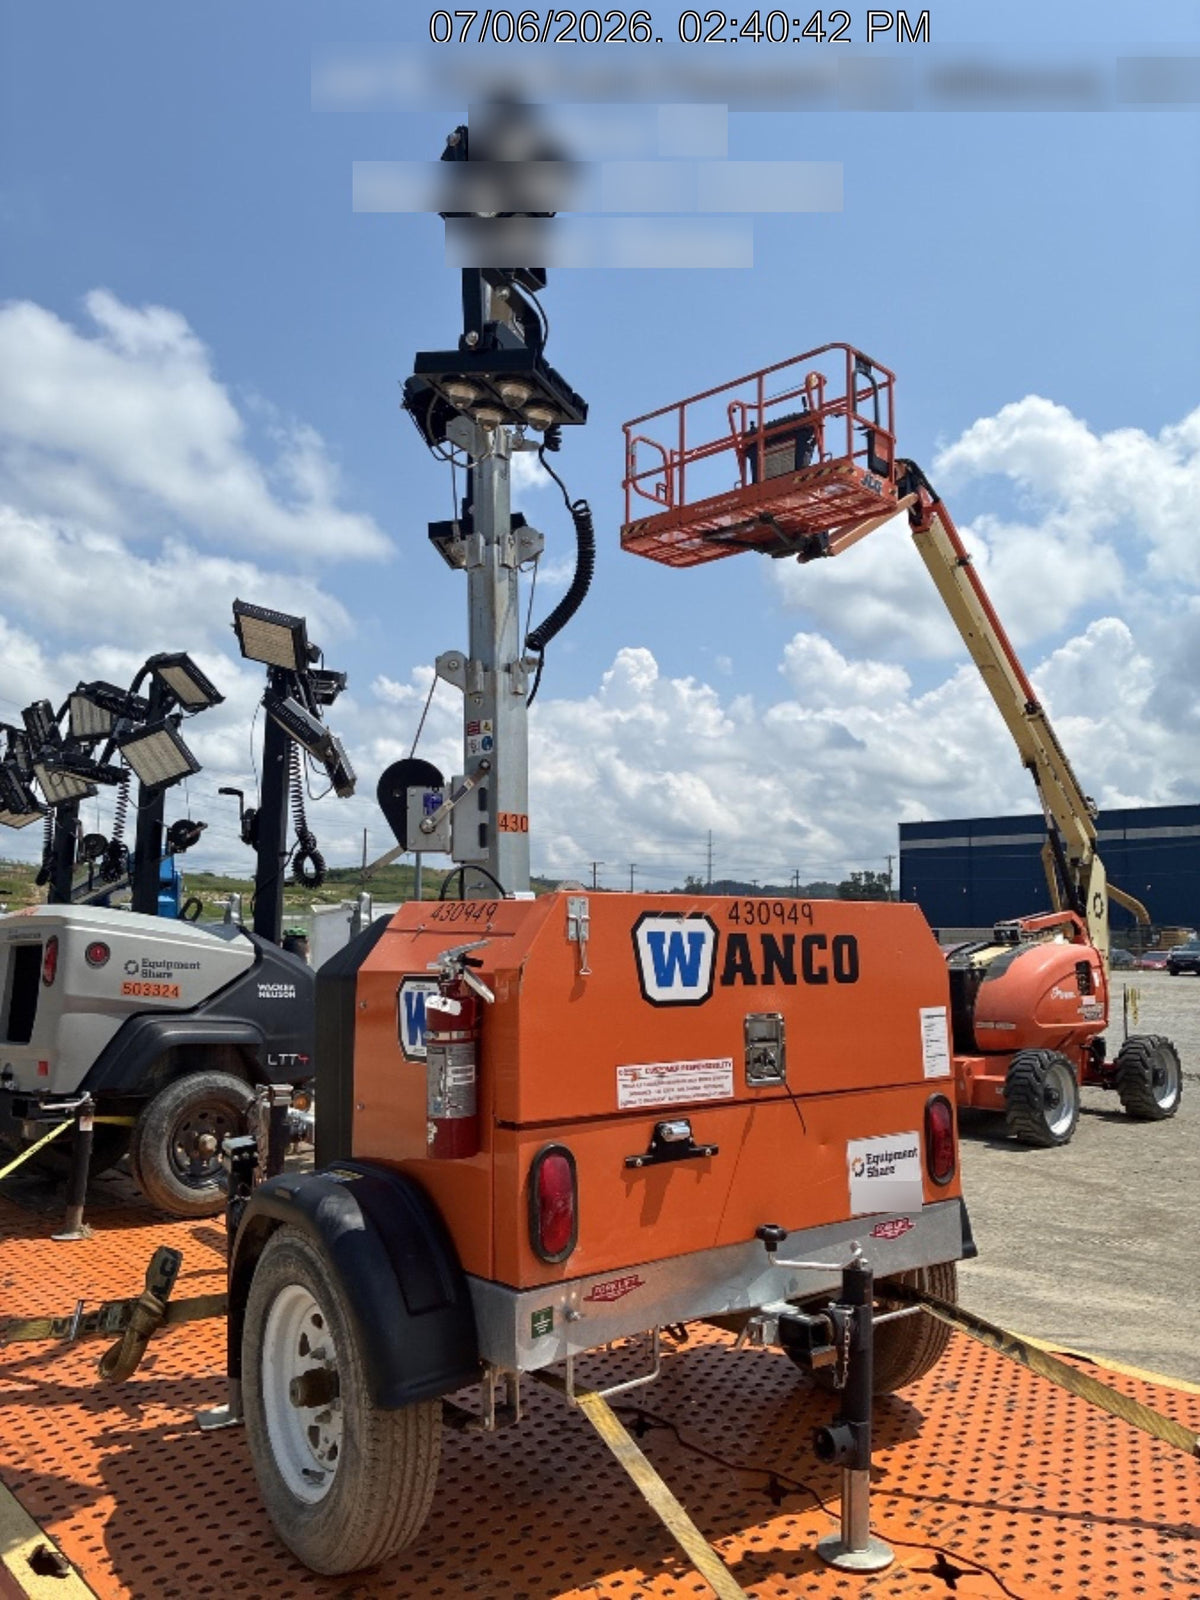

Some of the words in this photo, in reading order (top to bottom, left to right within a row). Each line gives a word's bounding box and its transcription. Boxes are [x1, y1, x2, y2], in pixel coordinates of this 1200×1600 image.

[500, 815, 529, 833] 430
[430, 902, 498, 922] 430949
[728, 901, 814, 926] 430949
[141, 958, 200, 971] Equipment
[646, 930, 860, 988] WANCO
[141, 968, 173, 979] Share
[123, 982, 179, 998] 503324
[865, 1147, 918, 1166] Equipment
[867, 1165, 896, 1178] Share
